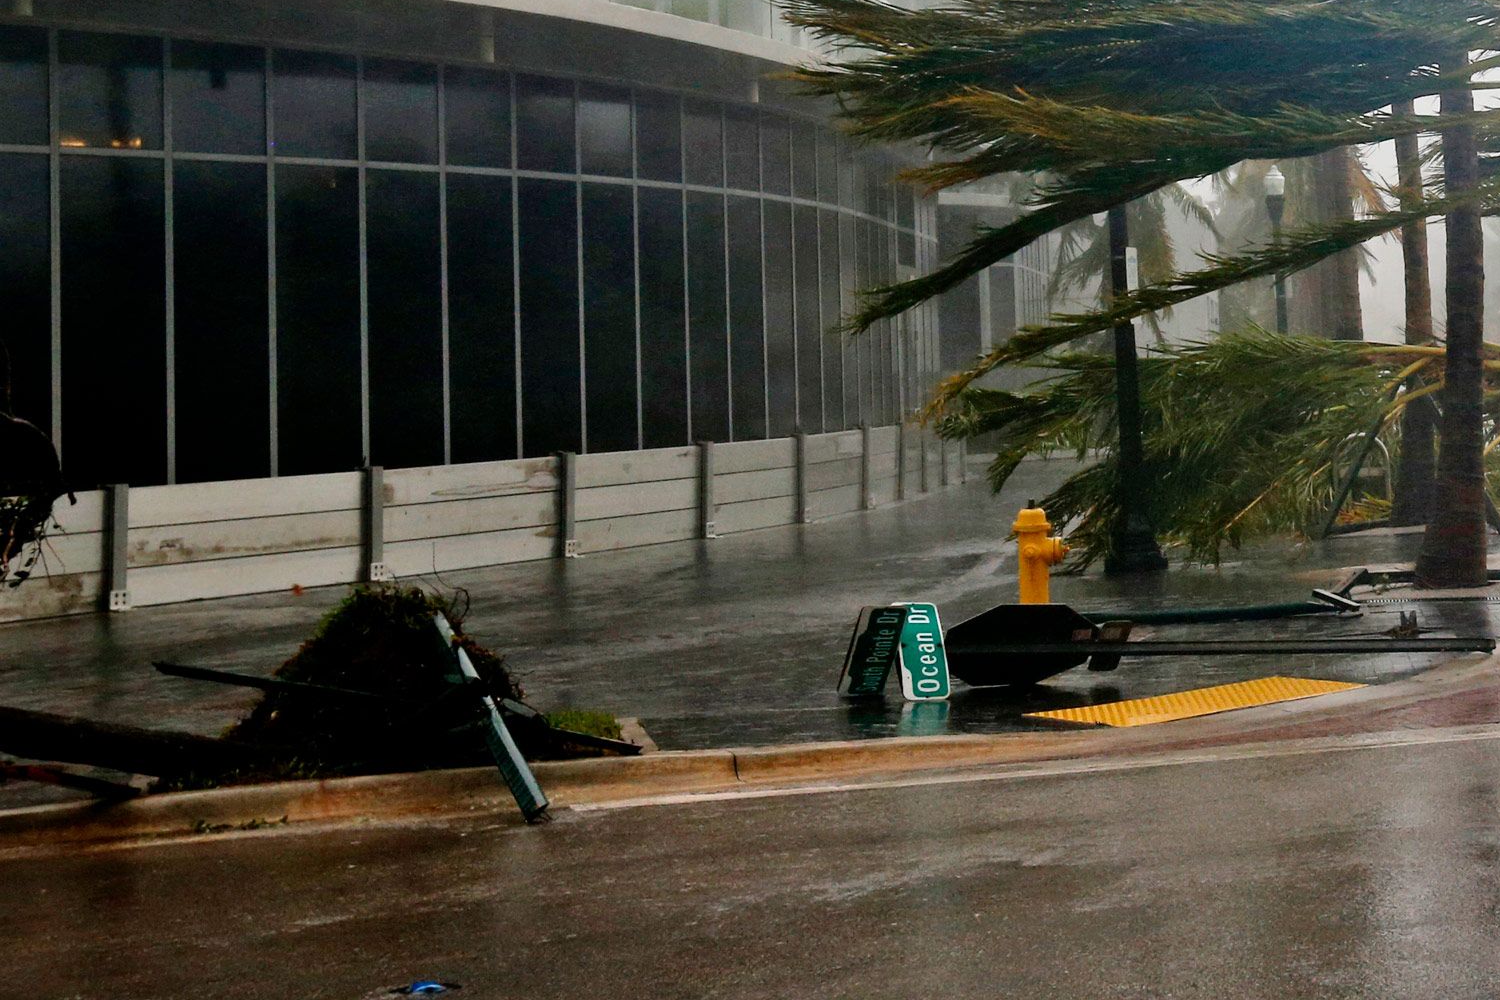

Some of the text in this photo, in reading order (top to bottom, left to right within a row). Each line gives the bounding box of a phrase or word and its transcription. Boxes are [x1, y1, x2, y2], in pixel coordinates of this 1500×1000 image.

[855, 610, 900, 692] South Pointe Dr
[907, 606, 941, 693] Ocean Dr
